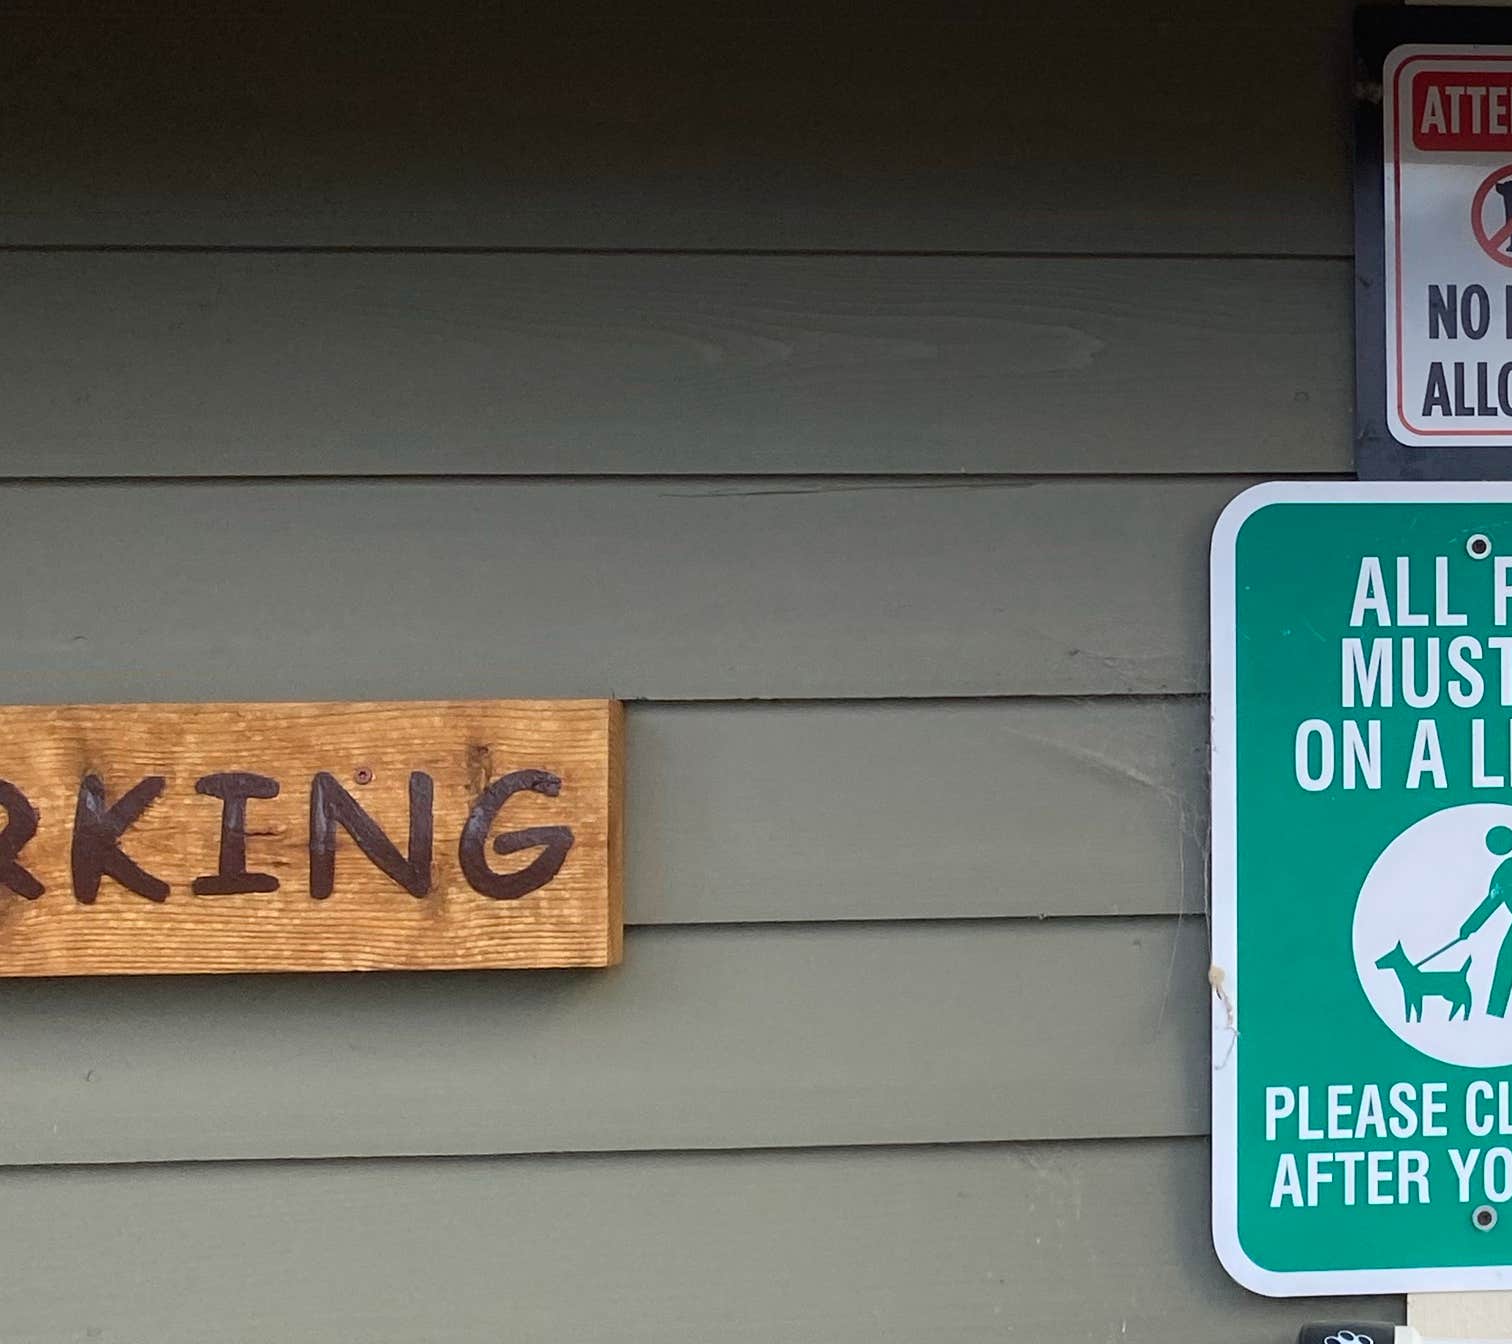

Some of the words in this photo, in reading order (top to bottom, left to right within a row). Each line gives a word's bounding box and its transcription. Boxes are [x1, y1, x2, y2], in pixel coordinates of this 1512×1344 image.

[1427, 284, 1491, 340] NO
[1349, 556, 1468, 627] ALL
[1294, 718, 1382, 792] ON
[1405, 719, 1448, 789] A
[1265, 1083, 1448, 1141] PLEASE
[1270, 1150, 1431, 1208] AFTER
